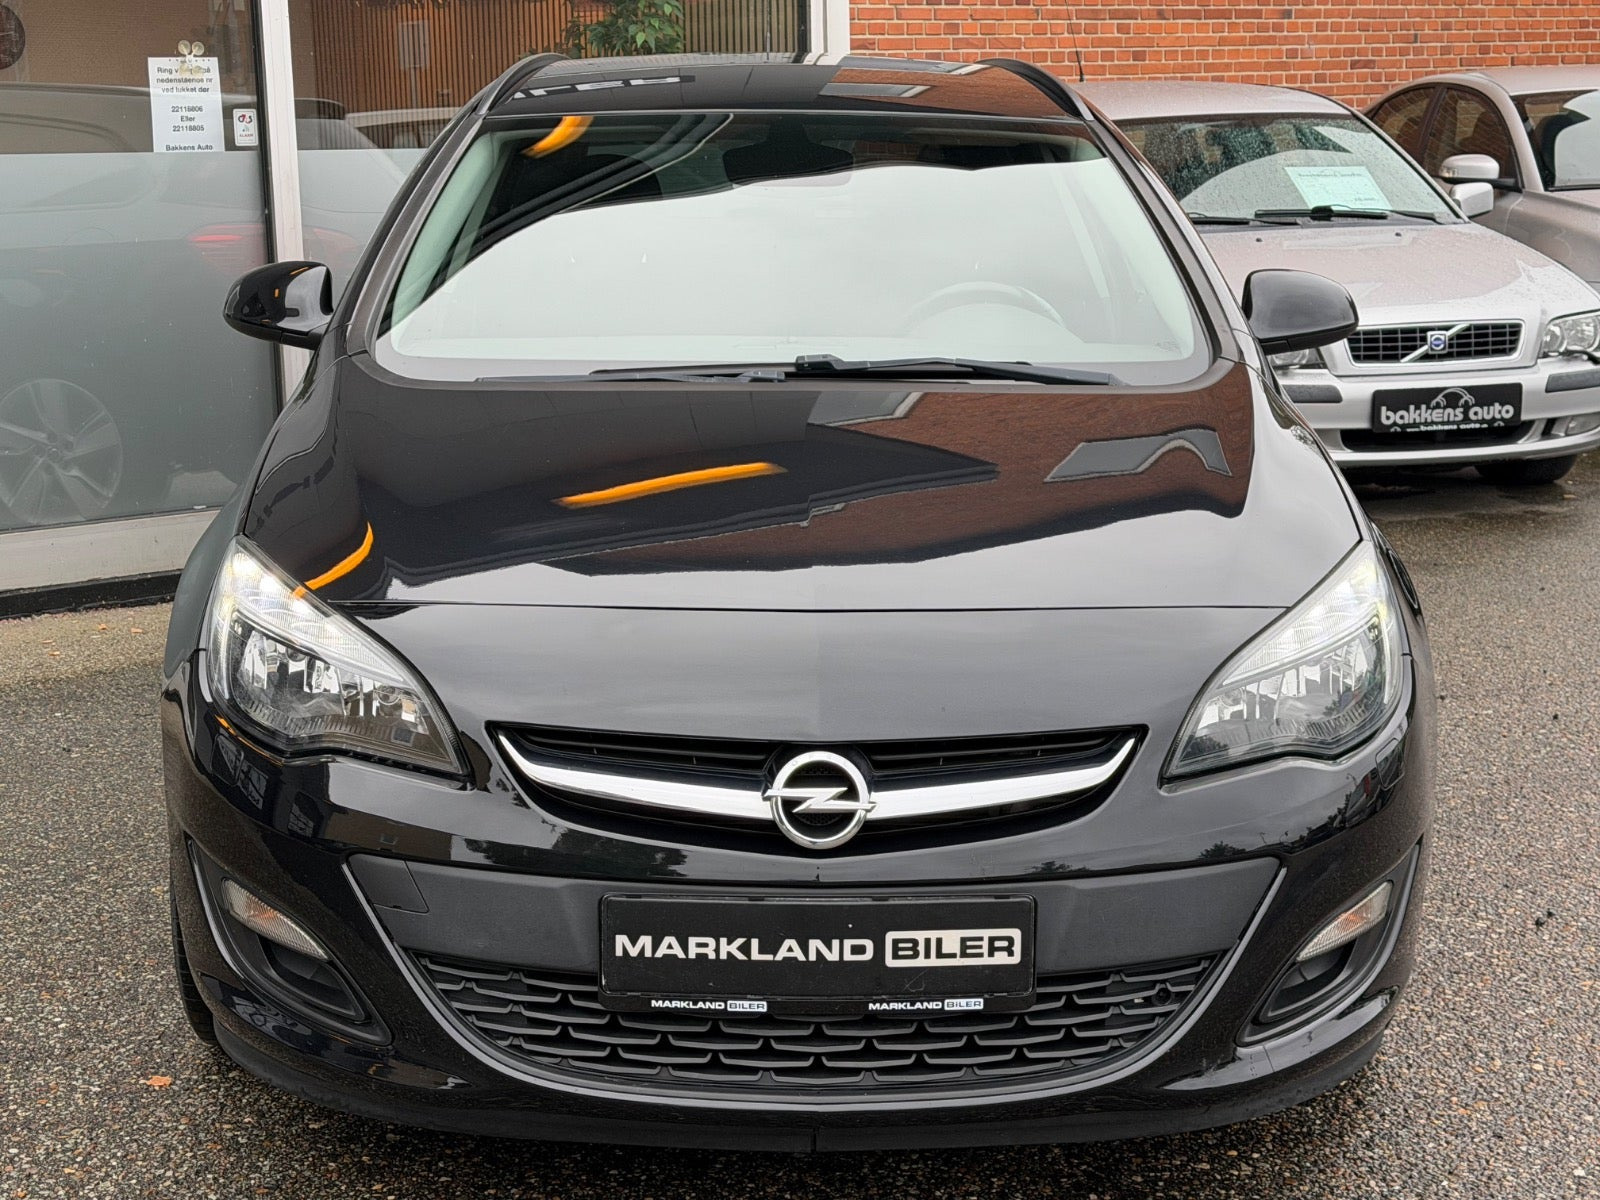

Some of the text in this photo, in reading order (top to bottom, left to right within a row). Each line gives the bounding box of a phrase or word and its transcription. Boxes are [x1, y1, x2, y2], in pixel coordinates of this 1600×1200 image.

[157, 66, 173, 75] Ring
[1381, 403, 1514, 425] bakkens auto
[614, 934, 1016, 962] MARKLAND BILER
[651, 999, 765, 1010] MARKLAND BILER
[868, 1000, 982, 1011] MARKLAND BILER
